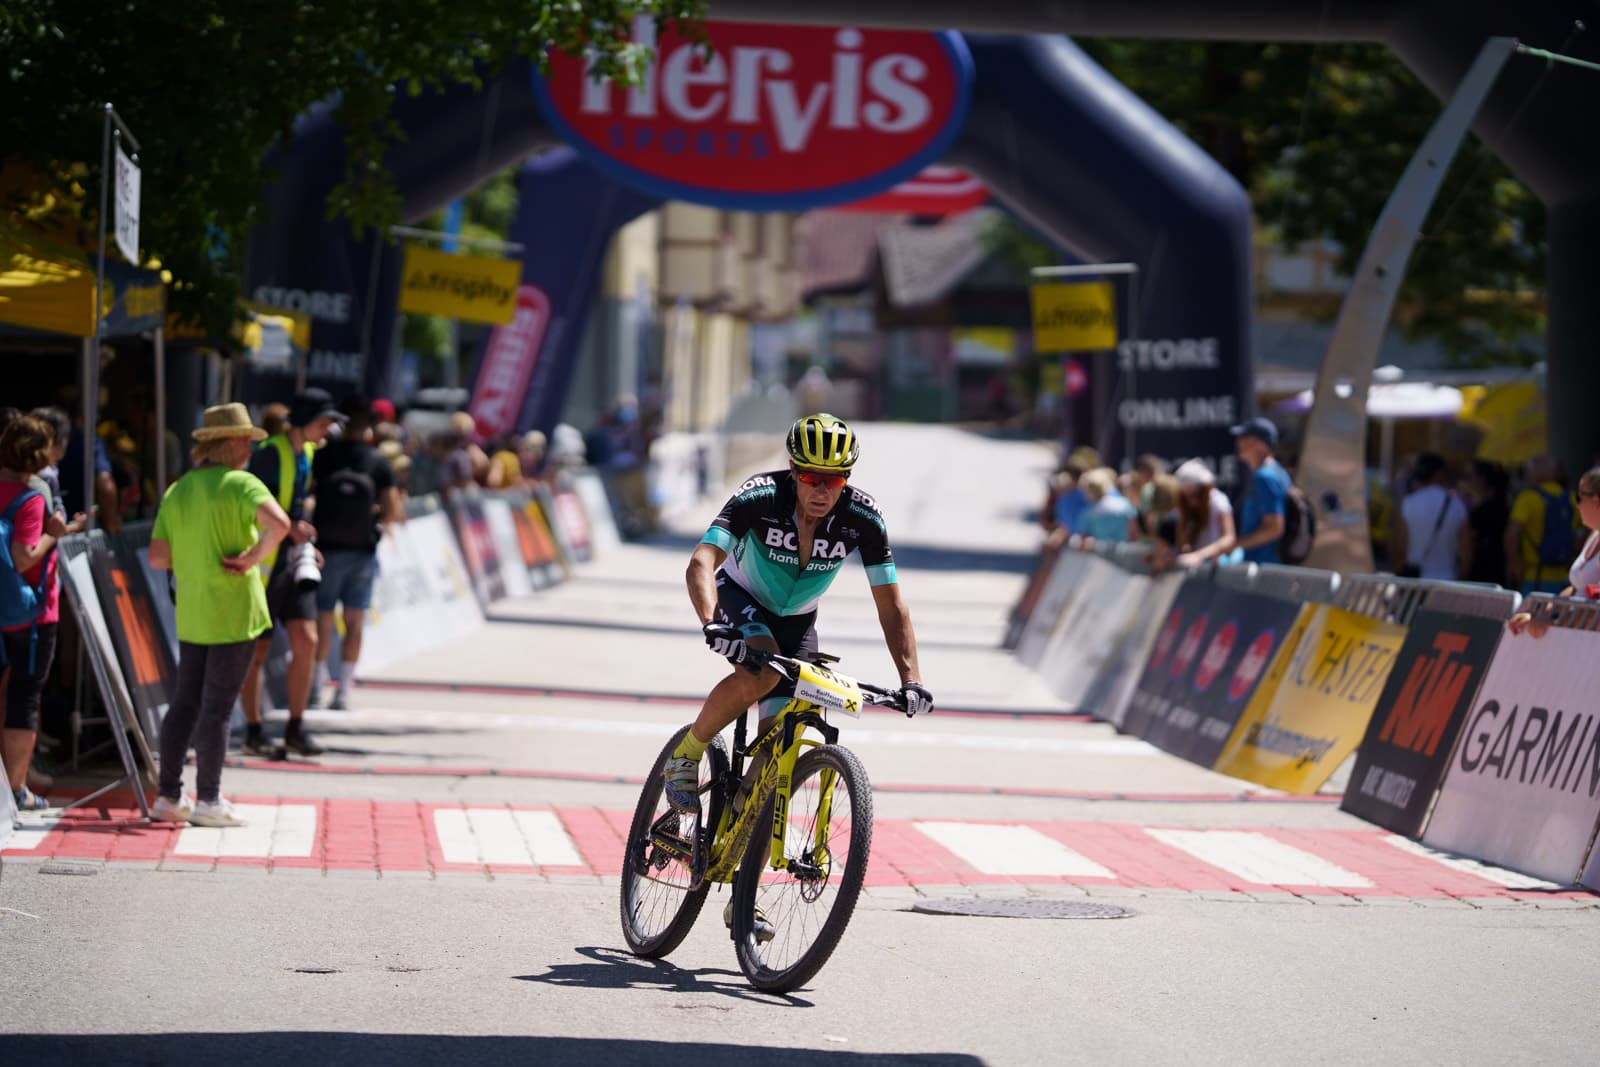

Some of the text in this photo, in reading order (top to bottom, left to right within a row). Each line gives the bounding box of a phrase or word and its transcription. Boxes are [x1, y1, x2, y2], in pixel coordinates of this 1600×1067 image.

[580, 14, 932, 152] Hervis
[608, 125, 770, 160] SPORTS
[1118, 336, 1219, 371] STORE
[1118, 396, 1235, 429] ONLINE
[1379, 631, 1472, 758] KTM
[1460, 699, 1600, 798] GARMIN
[652, 837, 679, 856] SCOTT
